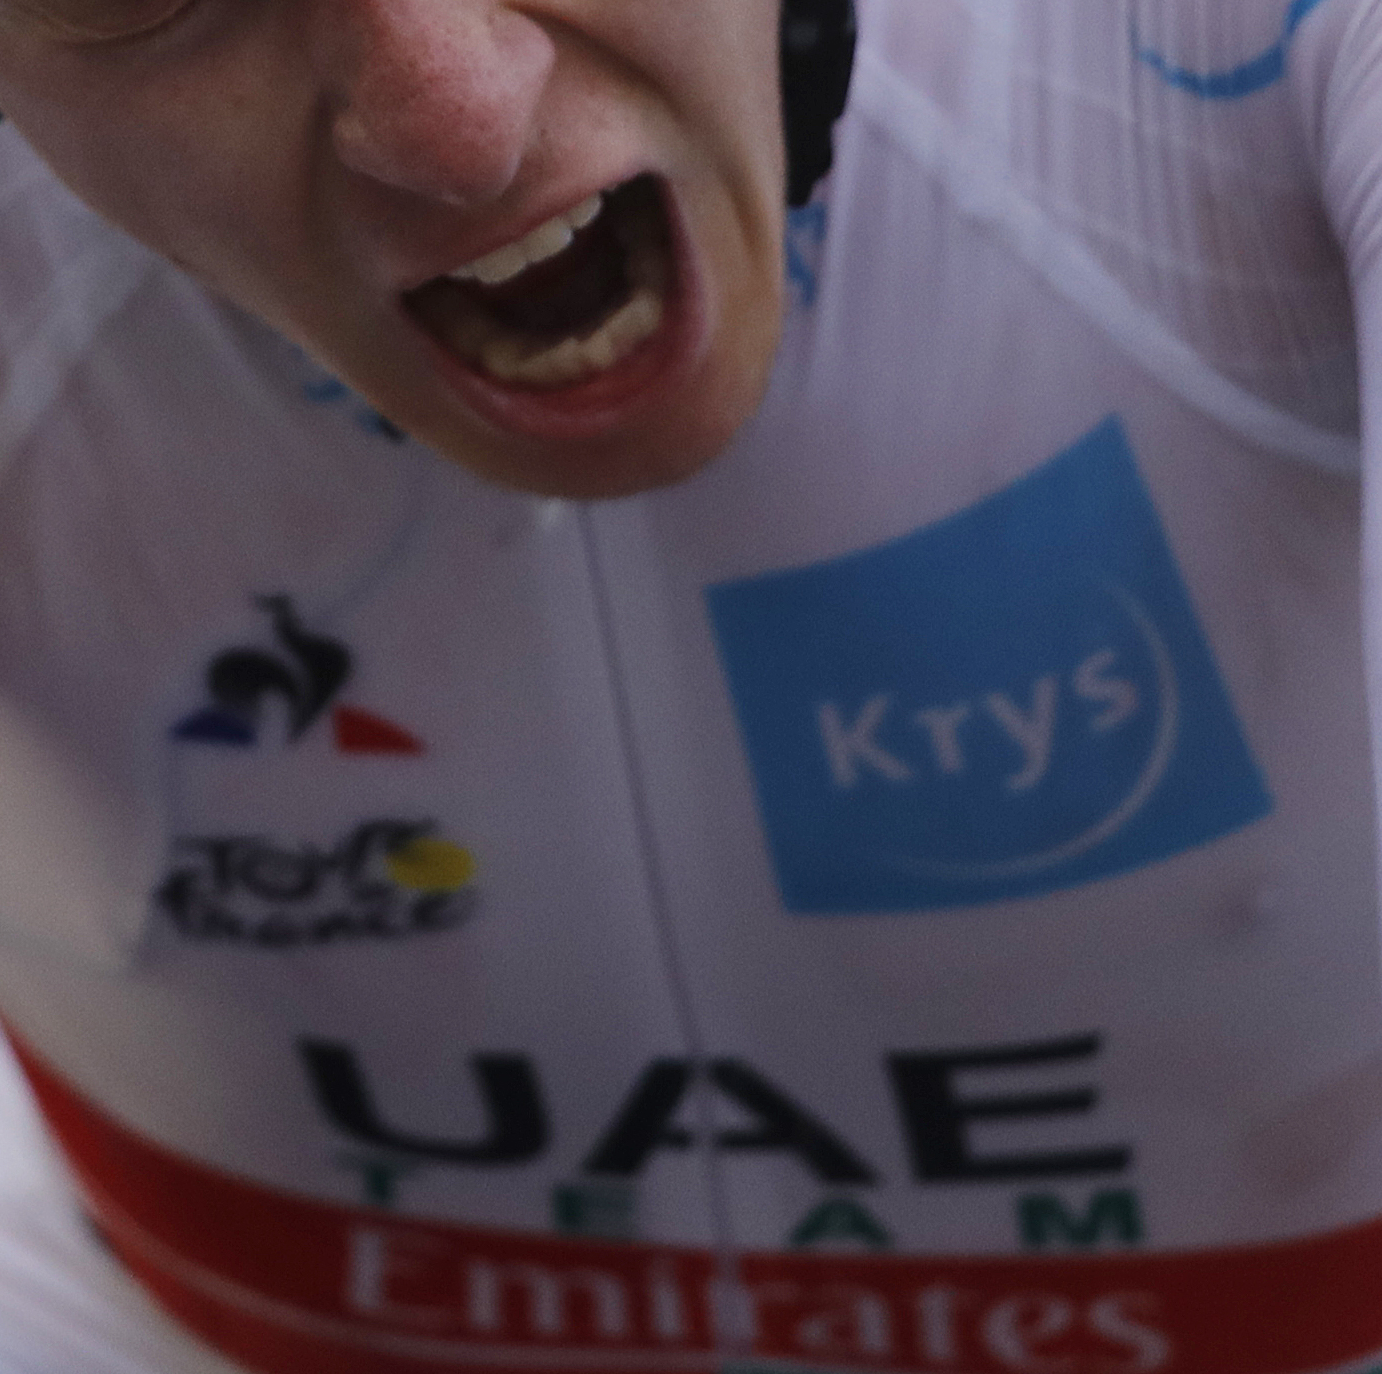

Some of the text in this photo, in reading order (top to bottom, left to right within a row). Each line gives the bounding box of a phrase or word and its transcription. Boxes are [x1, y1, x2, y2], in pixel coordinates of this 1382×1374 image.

[820, 648, 1140, 789] Krys
[296, 1031, 1135, 1187] UAE
[337, 1148, 1145, 1252] TEAM
[341, 1226, 1172, 1372] Emirates
